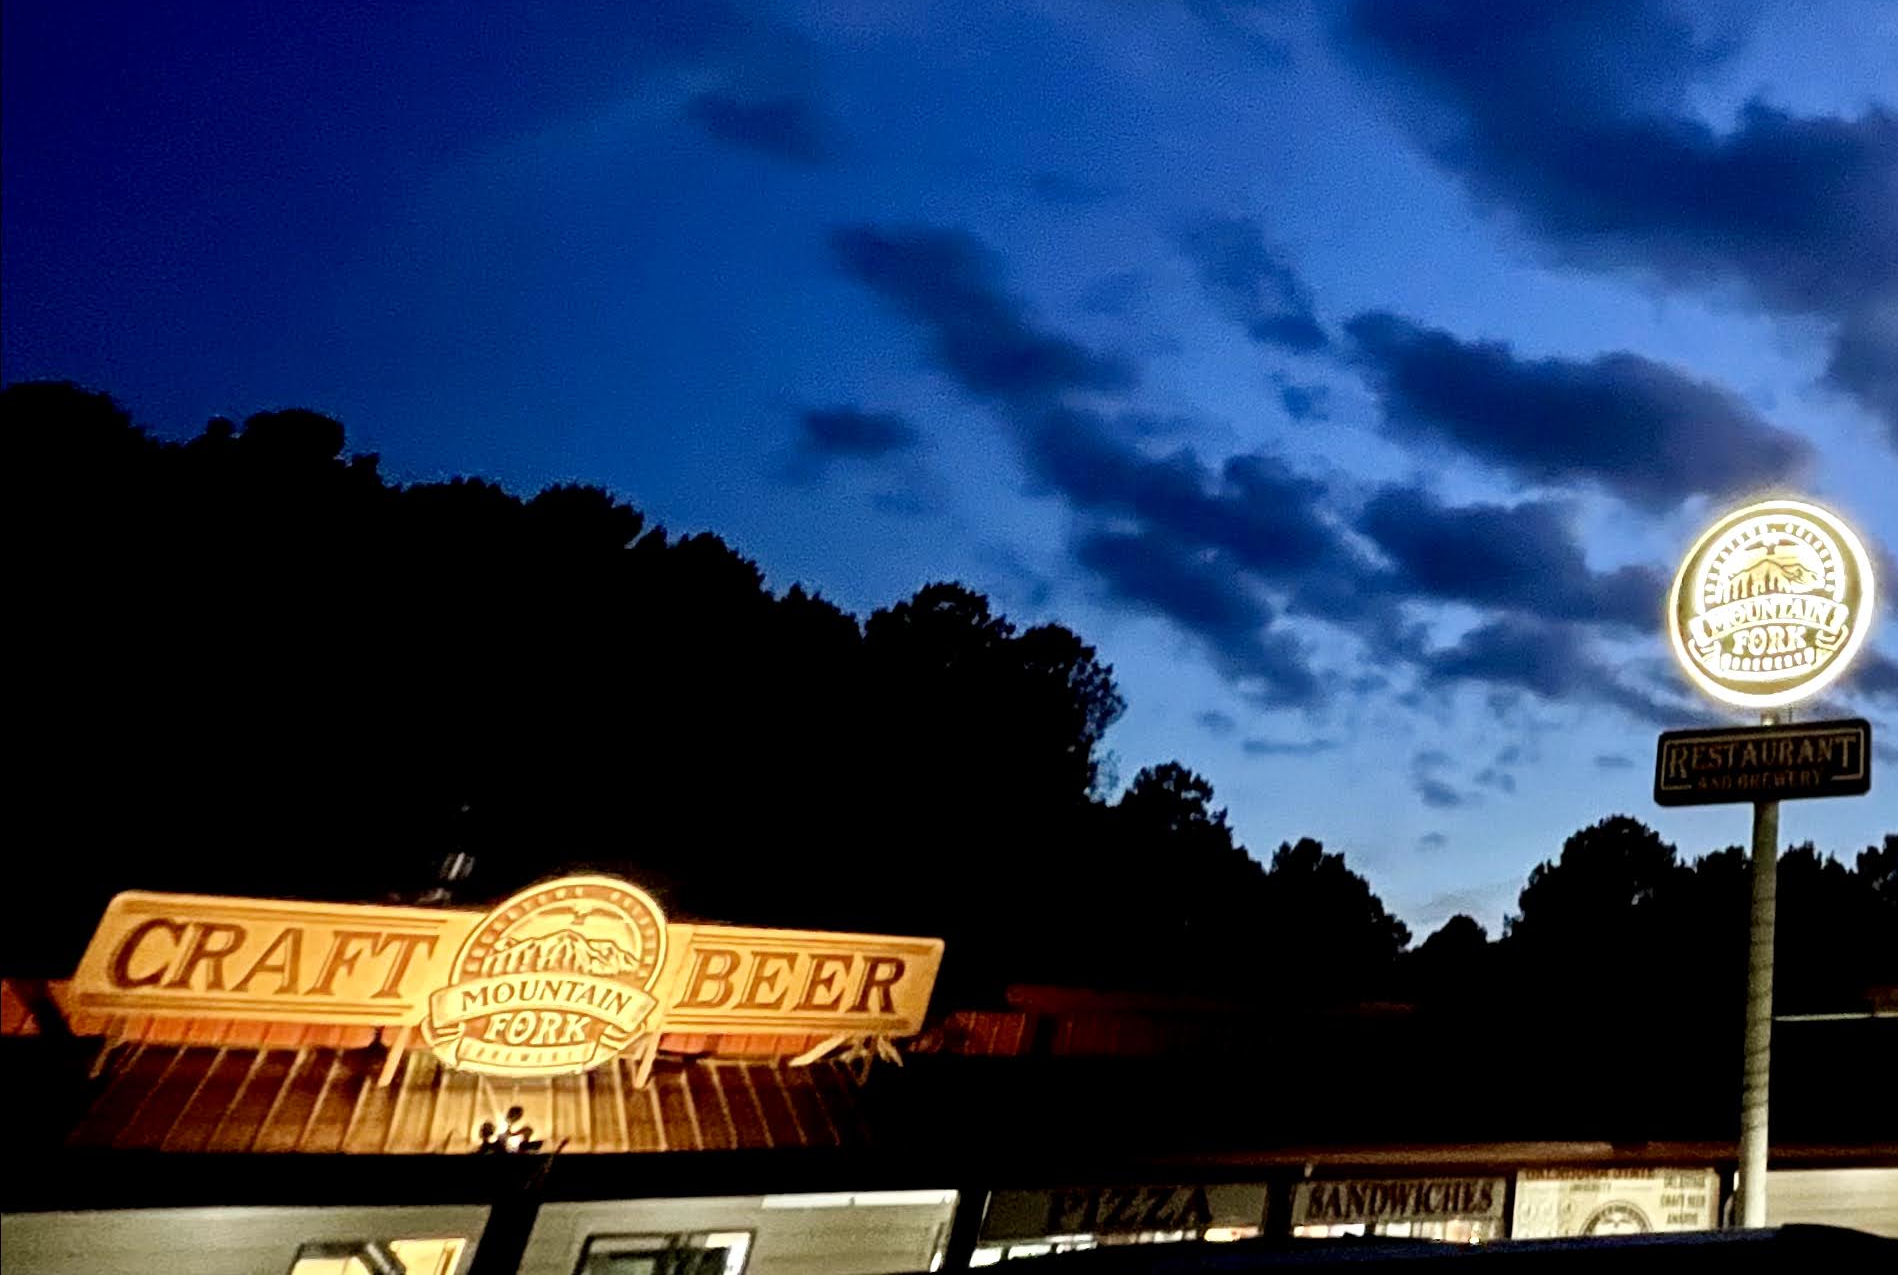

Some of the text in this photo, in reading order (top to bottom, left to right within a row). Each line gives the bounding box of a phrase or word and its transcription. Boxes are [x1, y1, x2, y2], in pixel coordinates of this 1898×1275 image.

[1731, 625, 1807, 656] FORK
[1668, 735, 1858, 779] RESTAURANT
[107, 917, 440, 1000] CRAFT
[672, 948, 906, 1014] BEER
[461, 979, 633, 1016] MOUNTAIN
[483, 1010, 593, 1045] FORK
[1048, 1186, 1214, 1232] PIZZA
[1306, 1180, 1494, 1218] SANDWICHES
